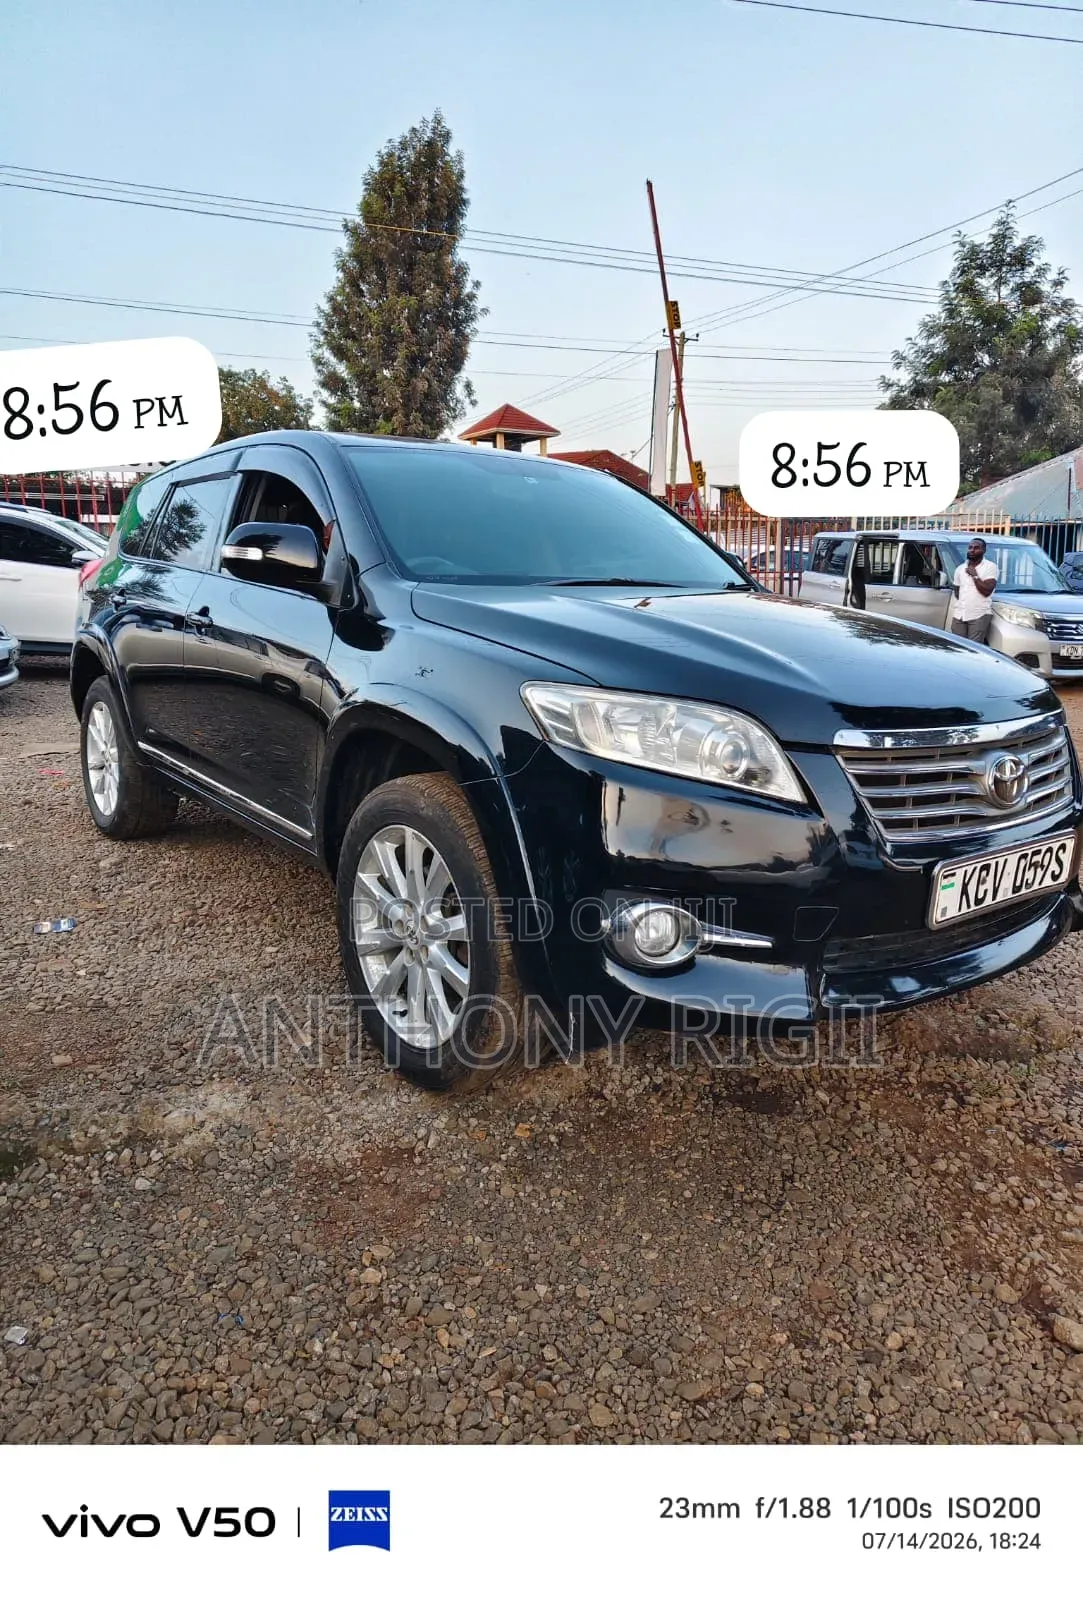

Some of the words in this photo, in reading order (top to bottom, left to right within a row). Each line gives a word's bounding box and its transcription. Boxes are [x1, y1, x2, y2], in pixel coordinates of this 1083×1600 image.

[670, 300, 681, 329] STOP
[957, 858, 1009, 913] KCV
[1011, 842, 1067, 895] 059S
